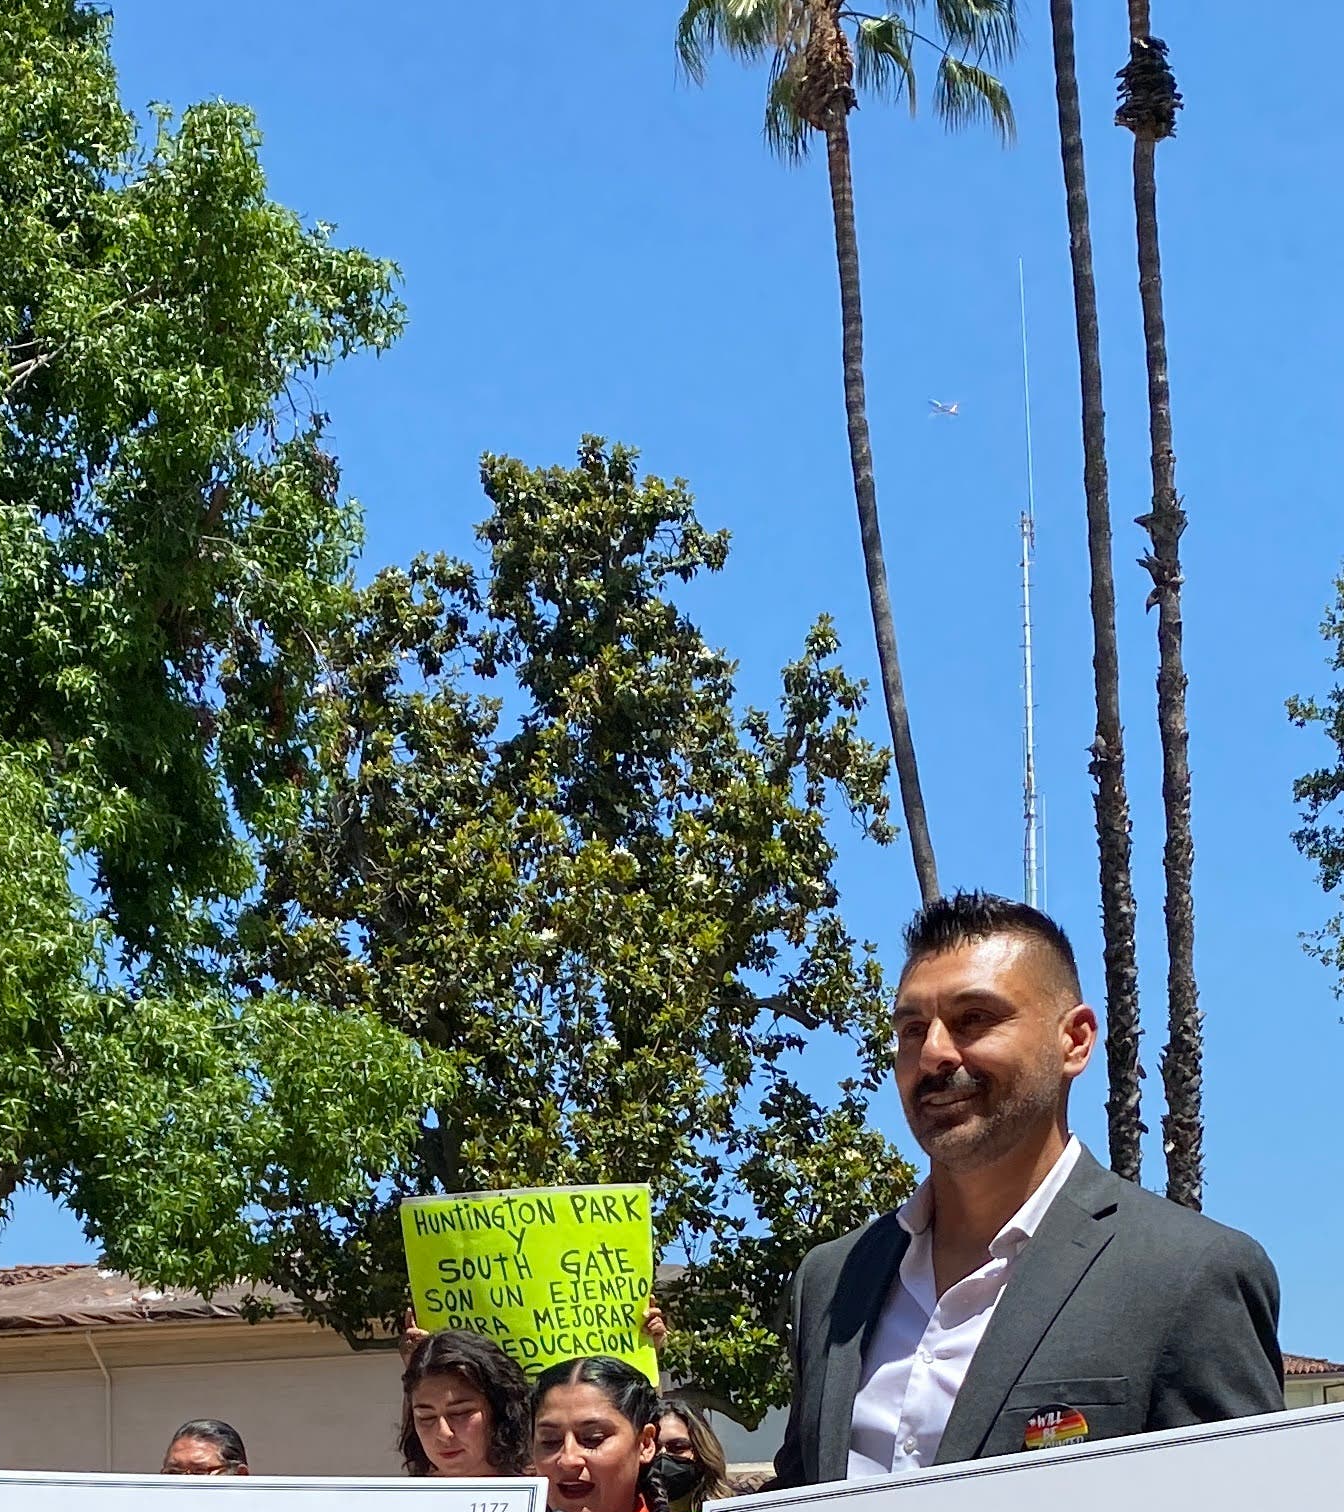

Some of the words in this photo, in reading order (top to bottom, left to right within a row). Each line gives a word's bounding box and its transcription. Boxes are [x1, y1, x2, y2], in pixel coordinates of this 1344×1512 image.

[570, 1194, 644, 1223] PARK
[508, 1227, 526, 1254] Y
[424, 1288, 474, 1313] SON
[489, 1284, 526, 1308] UN
[550, 1277, 649, 1305] EJEMPLO
[448, 1315, 510, 1336] PARA
[532, 1303, 636, 1332] MEJORAR
